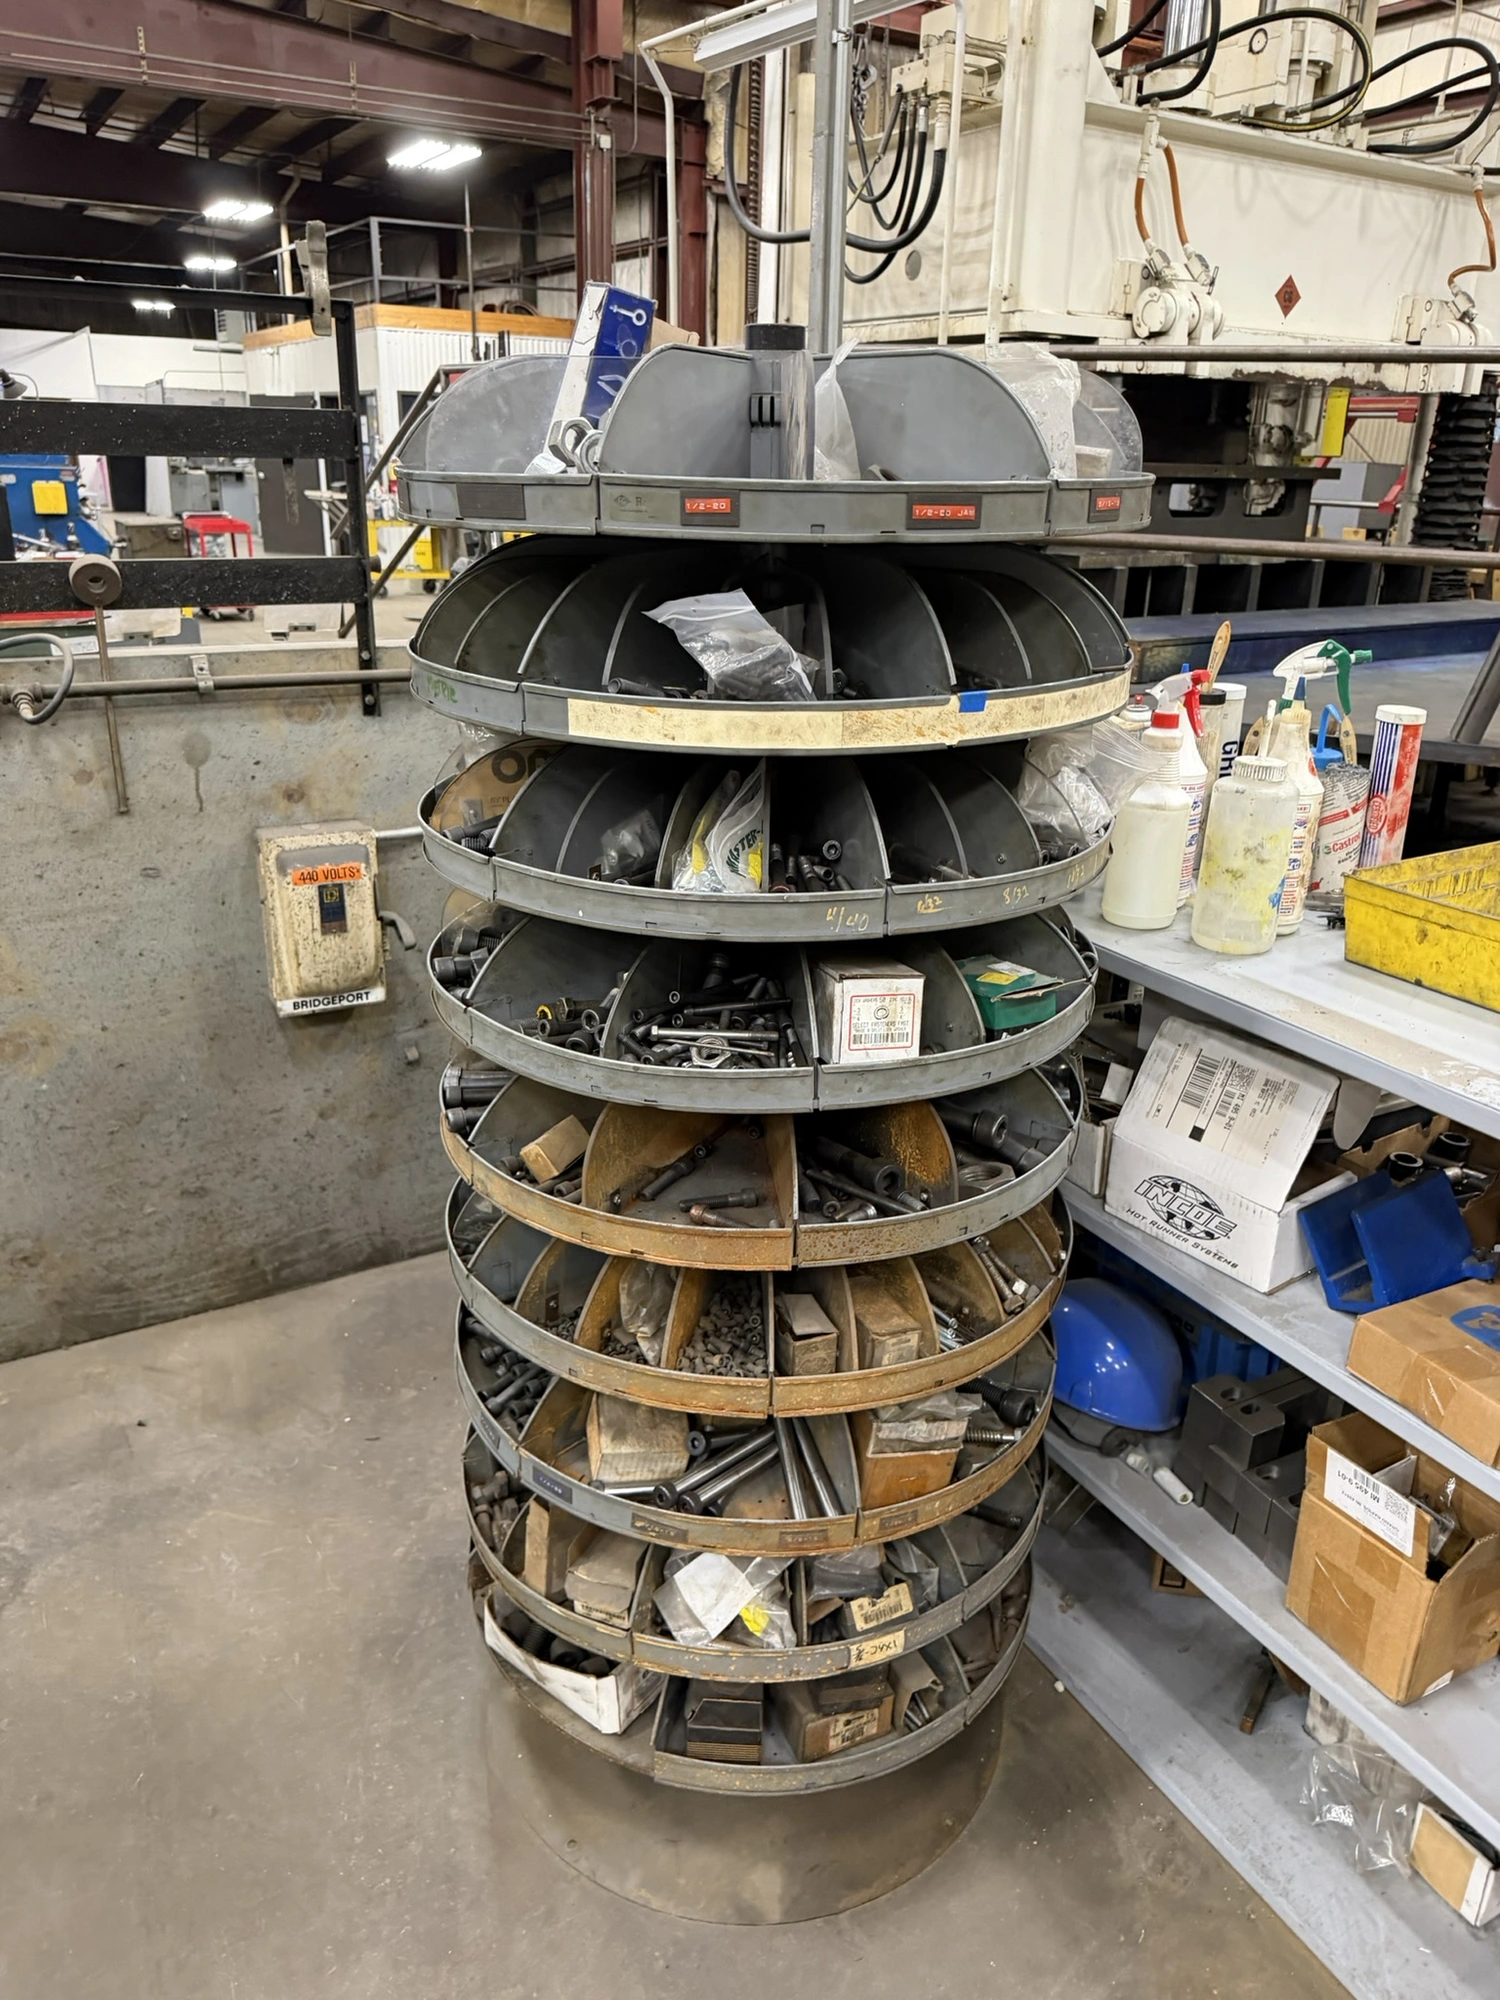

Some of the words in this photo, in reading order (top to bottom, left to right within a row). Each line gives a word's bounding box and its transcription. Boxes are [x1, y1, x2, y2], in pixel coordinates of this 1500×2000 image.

[687, 501, 726, 511] 1/2-20
[915, 508, 951, 517] 1/2-20
[299, 870, 319, 884] 440
[322, 866, 356, 881] VOLTS
[293, 991, 370, 1011] BRIDGEPORT
[1237, 1092, 1245, 1102] MI
[1230, 1102, 1240, 1114] 495
[1134, 1179, 1237, 1237] INCOE
[1126, 1207, 1147, 1222] HOT
[1149, 1219, 1189, 1243] RUNNER
[1191, 1241, 1239, 1269] SYSTEMS
[1337, 1470, 1354, 1485] 9-01
[1353, 1482, 1370, 1495] 495
